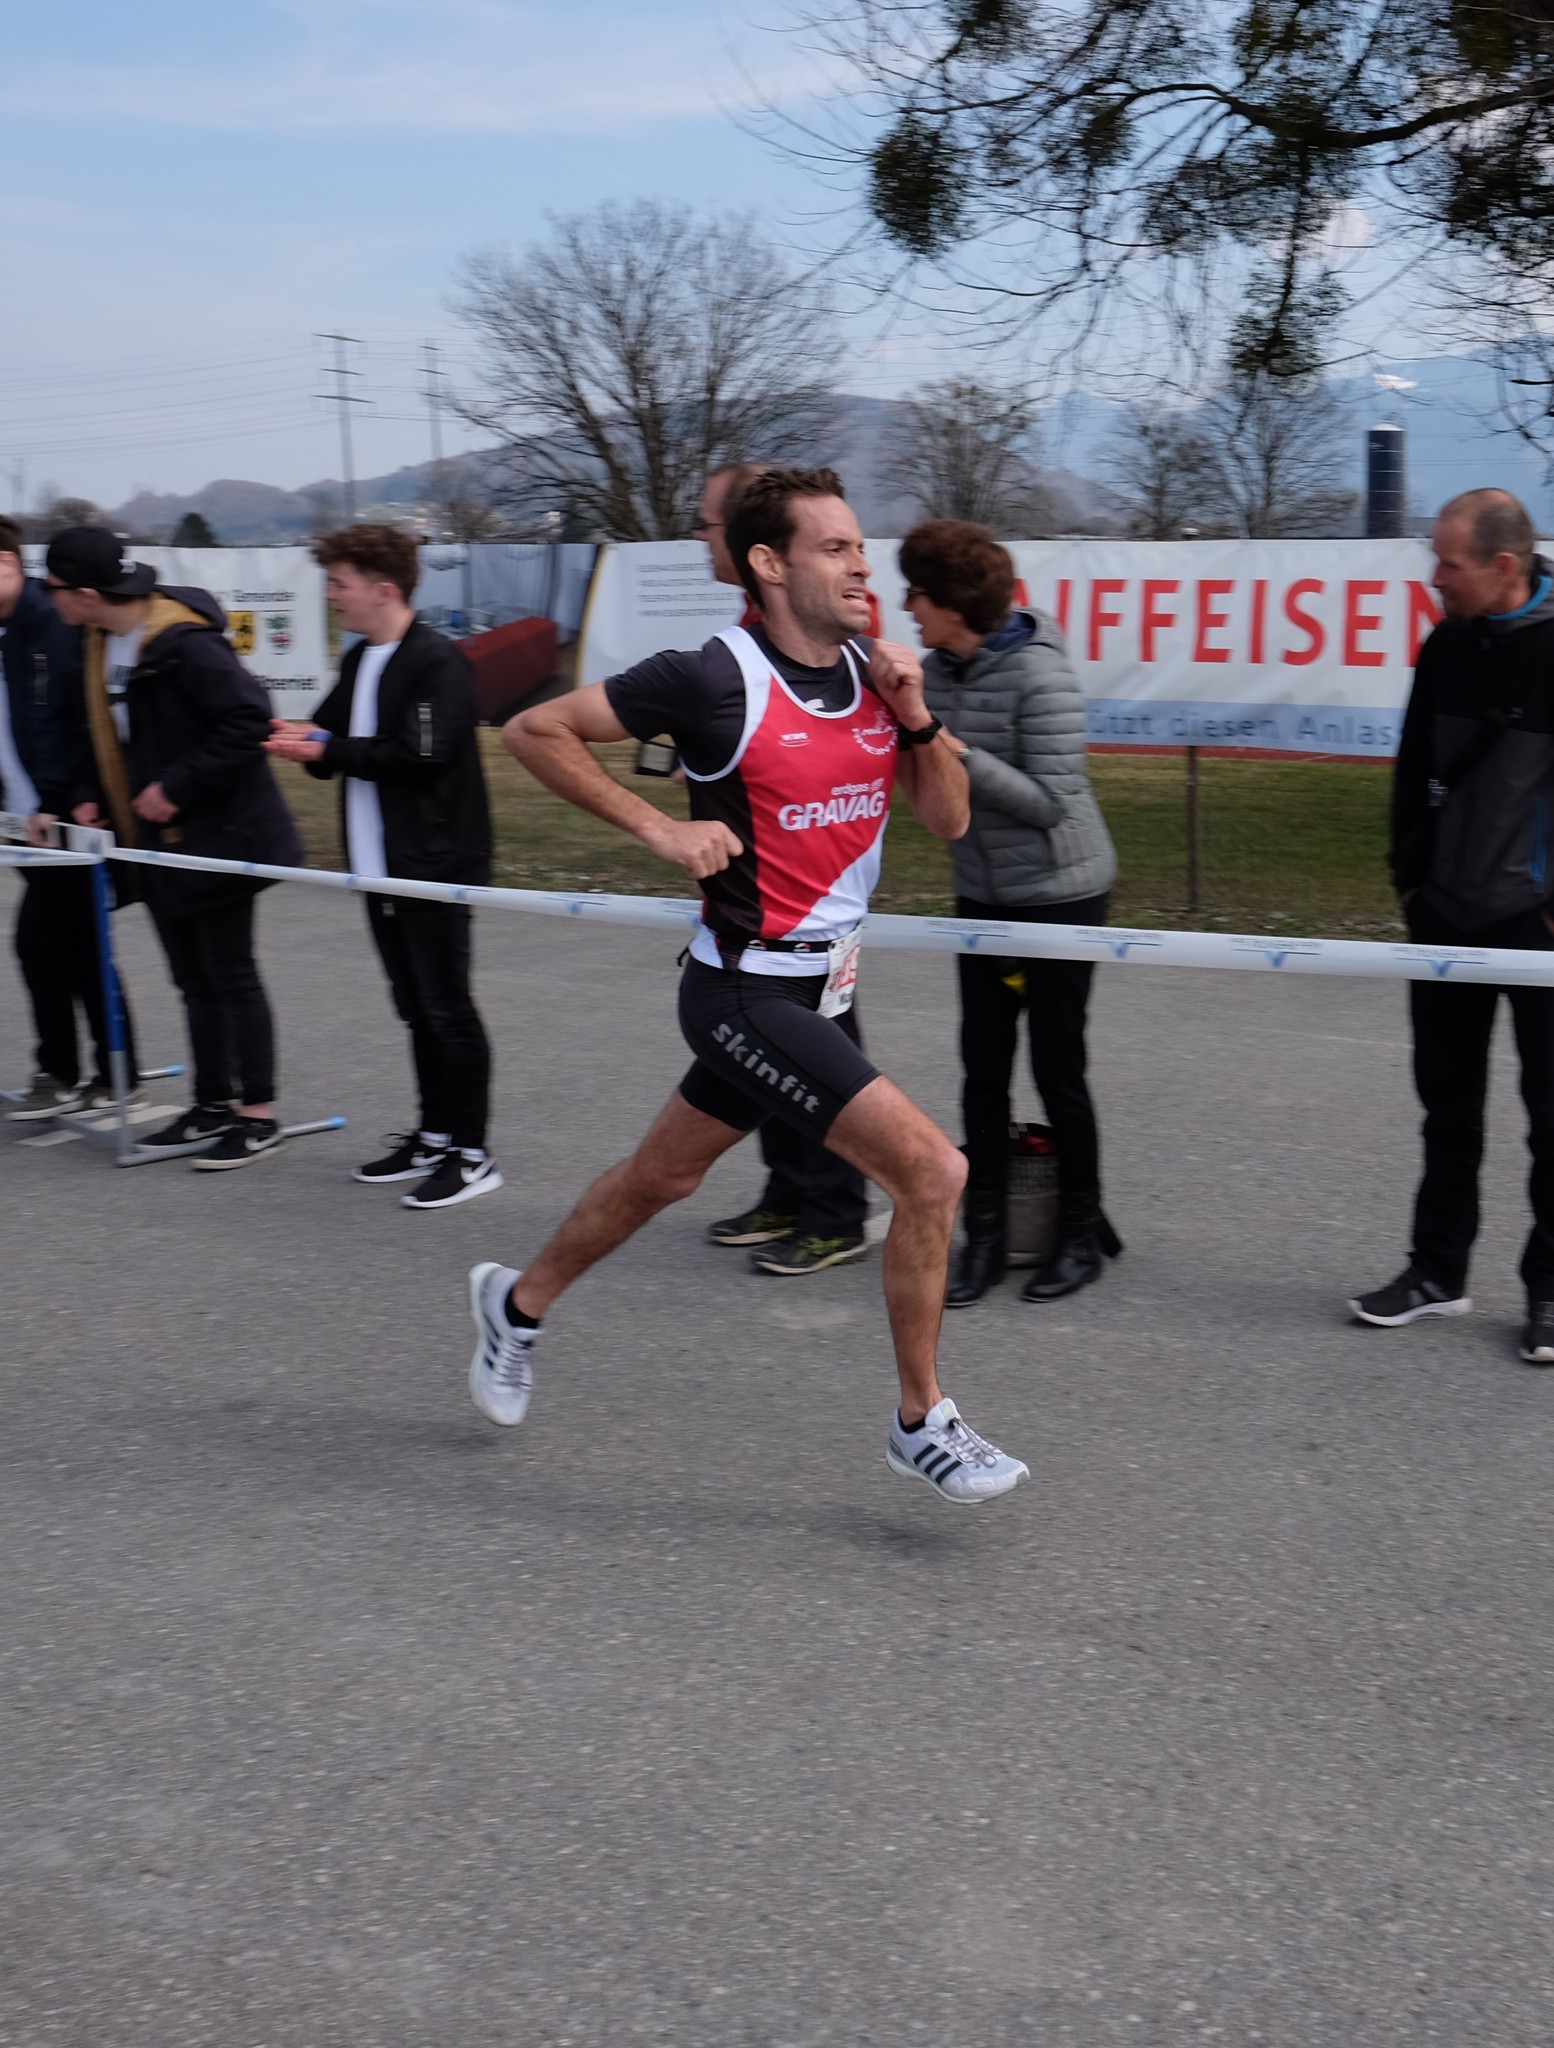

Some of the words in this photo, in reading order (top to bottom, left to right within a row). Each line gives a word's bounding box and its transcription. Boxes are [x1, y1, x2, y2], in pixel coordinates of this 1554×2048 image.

[1013, 578, 1446, 667] IFFEISEN
[1169, 710, 1279, 741] diesen
[1296, 716, 1403, 746] Anlas
[831, 783, 870, 796] erdgas
[778, 791, 886, 831] GRAVAG
[711, 1023, 821, 1113] skinfit
